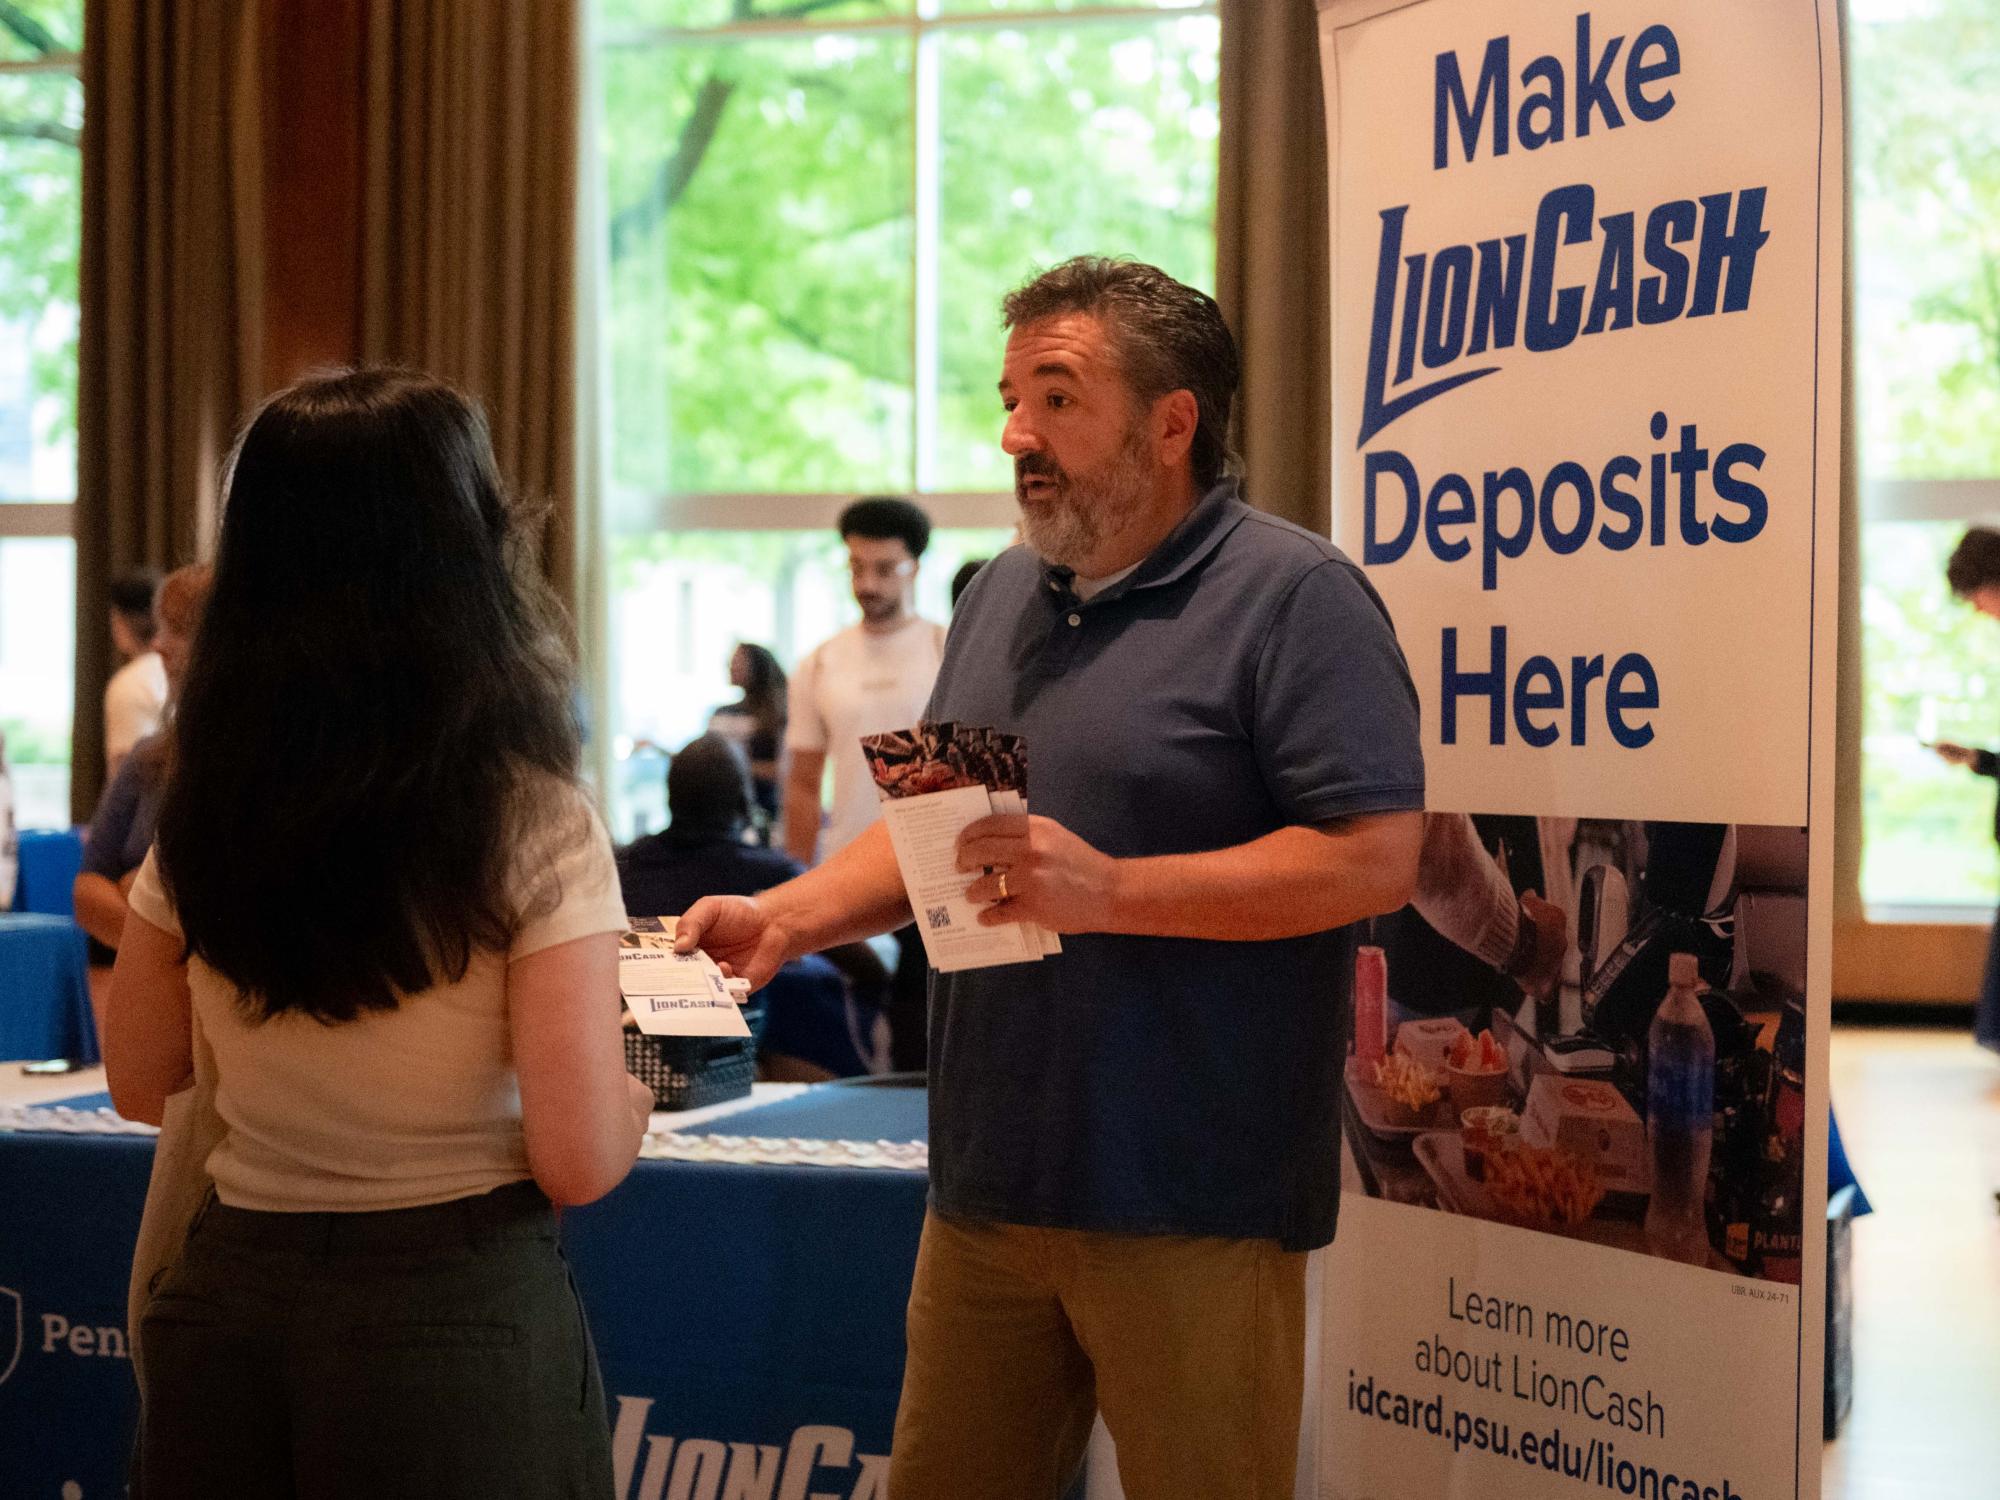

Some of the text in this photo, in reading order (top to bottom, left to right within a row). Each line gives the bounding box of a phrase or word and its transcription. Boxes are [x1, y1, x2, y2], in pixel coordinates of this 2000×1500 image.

[1433, 12, 1681, 170] Make
[1363, 411, 1769, 590] Deposits
[1441, 625, 1660, 749] Here
[41, 1313, 129, 1358] Pen
[1450, 1277, 1629, 1362] Learn more
[1415, 1334, 1664, 1438] about LionCash
